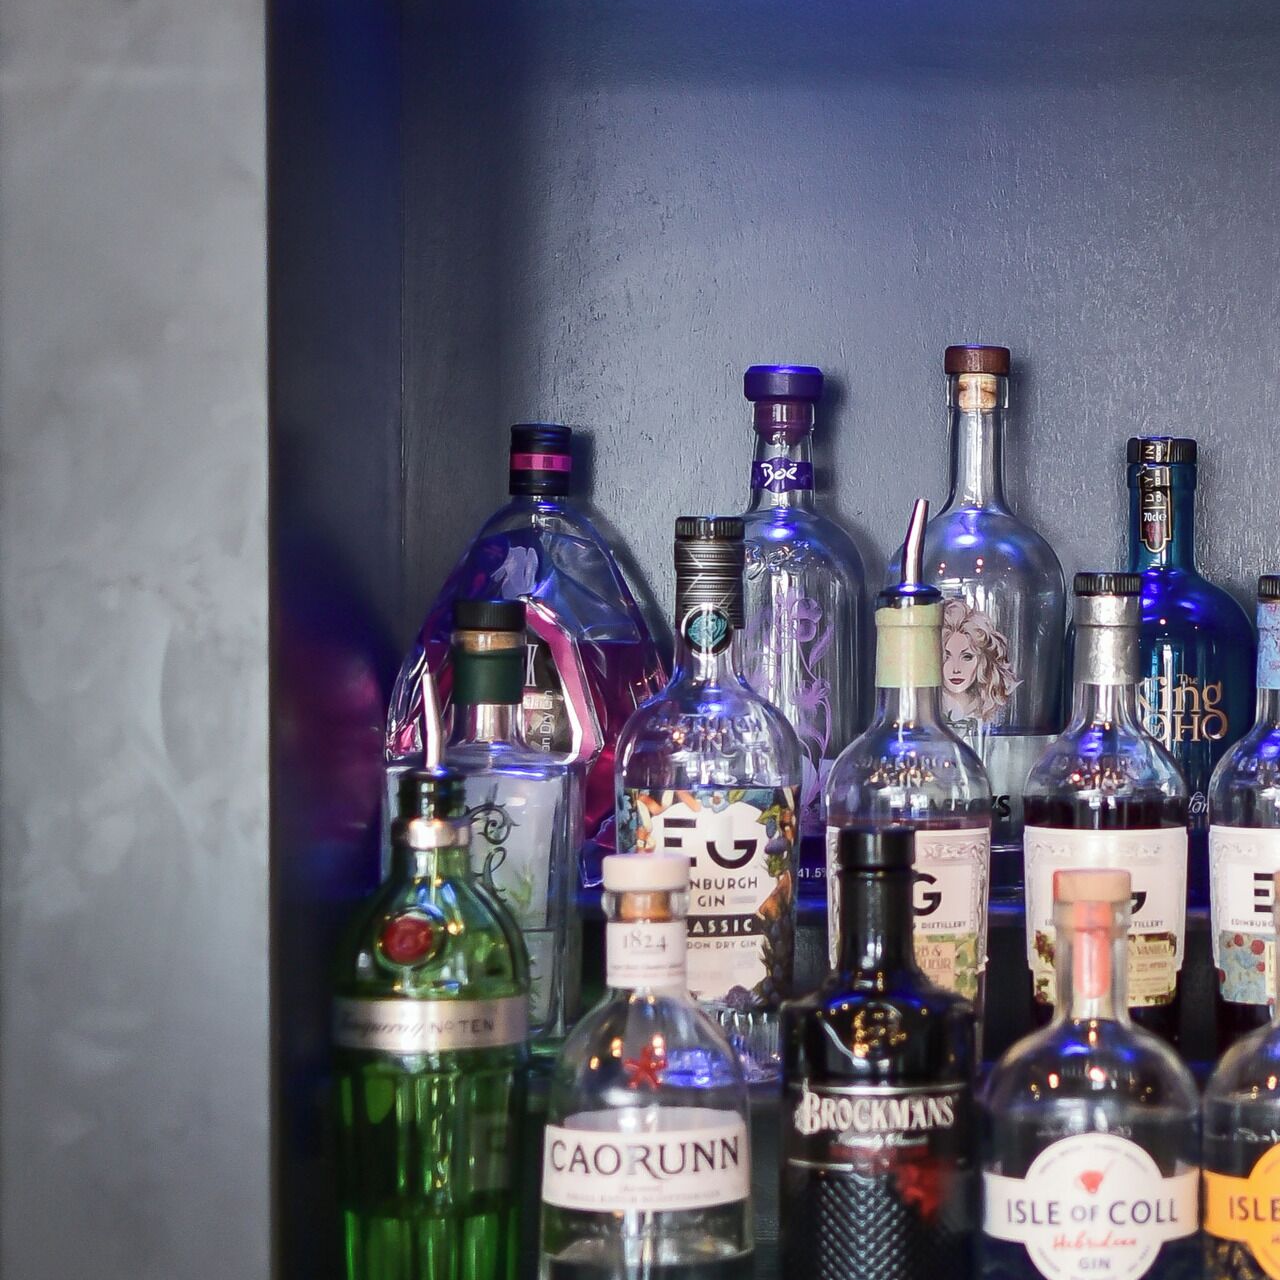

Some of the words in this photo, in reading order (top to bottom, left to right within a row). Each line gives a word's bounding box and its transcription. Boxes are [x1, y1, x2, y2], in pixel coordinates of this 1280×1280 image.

[760, 462, 798, 487] Boë
[1176, 673, 1200, 685] The
[1143, 712, 1228, 742] OHO
[689, 876, 759, 890] NBURGH
[1253, 872, 1275, 913] E
[697, 894, 726, 908] GIN
[687, 918, 753, 934] ASSIC
[623, 928, 668, 953] 1824
[687, 940, 711, 950] DON
[715, 940, 737, 950] DRY
[740, 939, 758, 948] GIN
[458, 1018, 495, 1034] TEN
[794, 1086, 955, 1136] BROCKMANS
[550, 1135, 740, 1180] CAORUNN
[1006, 1198, 1061, 1225] ISLE
[1070, 1204, 1099, 1222] OF
[1108, 1198, 1179, 1225] COLL
[1078, 1256, 1111, 1270] GIN
